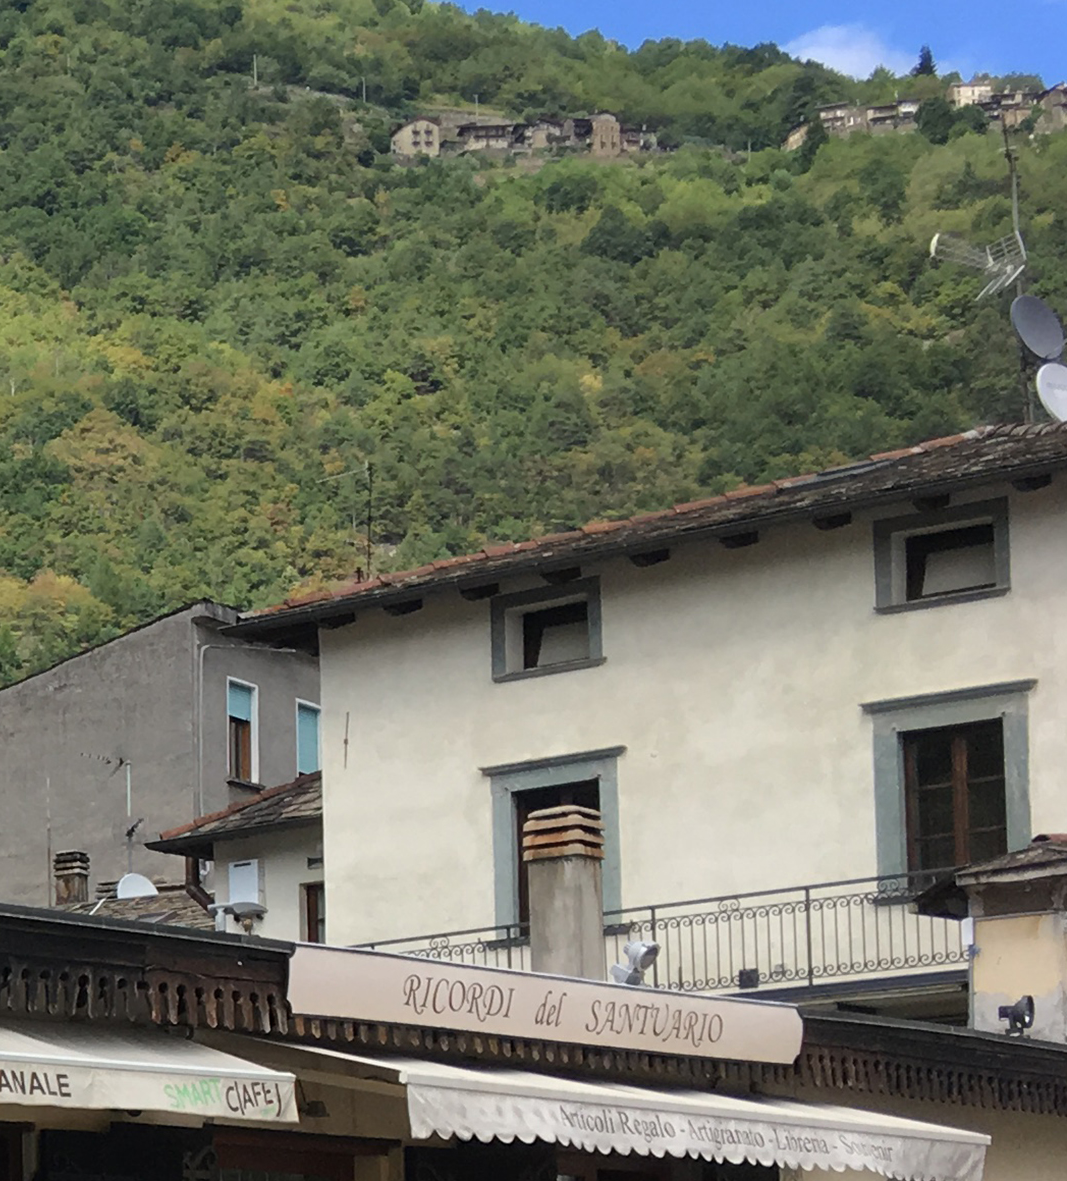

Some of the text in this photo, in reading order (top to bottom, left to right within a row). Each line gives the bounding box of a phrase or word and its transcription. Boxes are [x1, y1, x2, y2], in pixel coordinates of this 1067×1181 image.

[402, 973, 724, 1048] RICORDI del SANTUARIO
[163, 1078, 222, 1109] SMART
[560, 1105, 615, 1134] Articoli
[617, 1111, 676, 1143] Regalo
